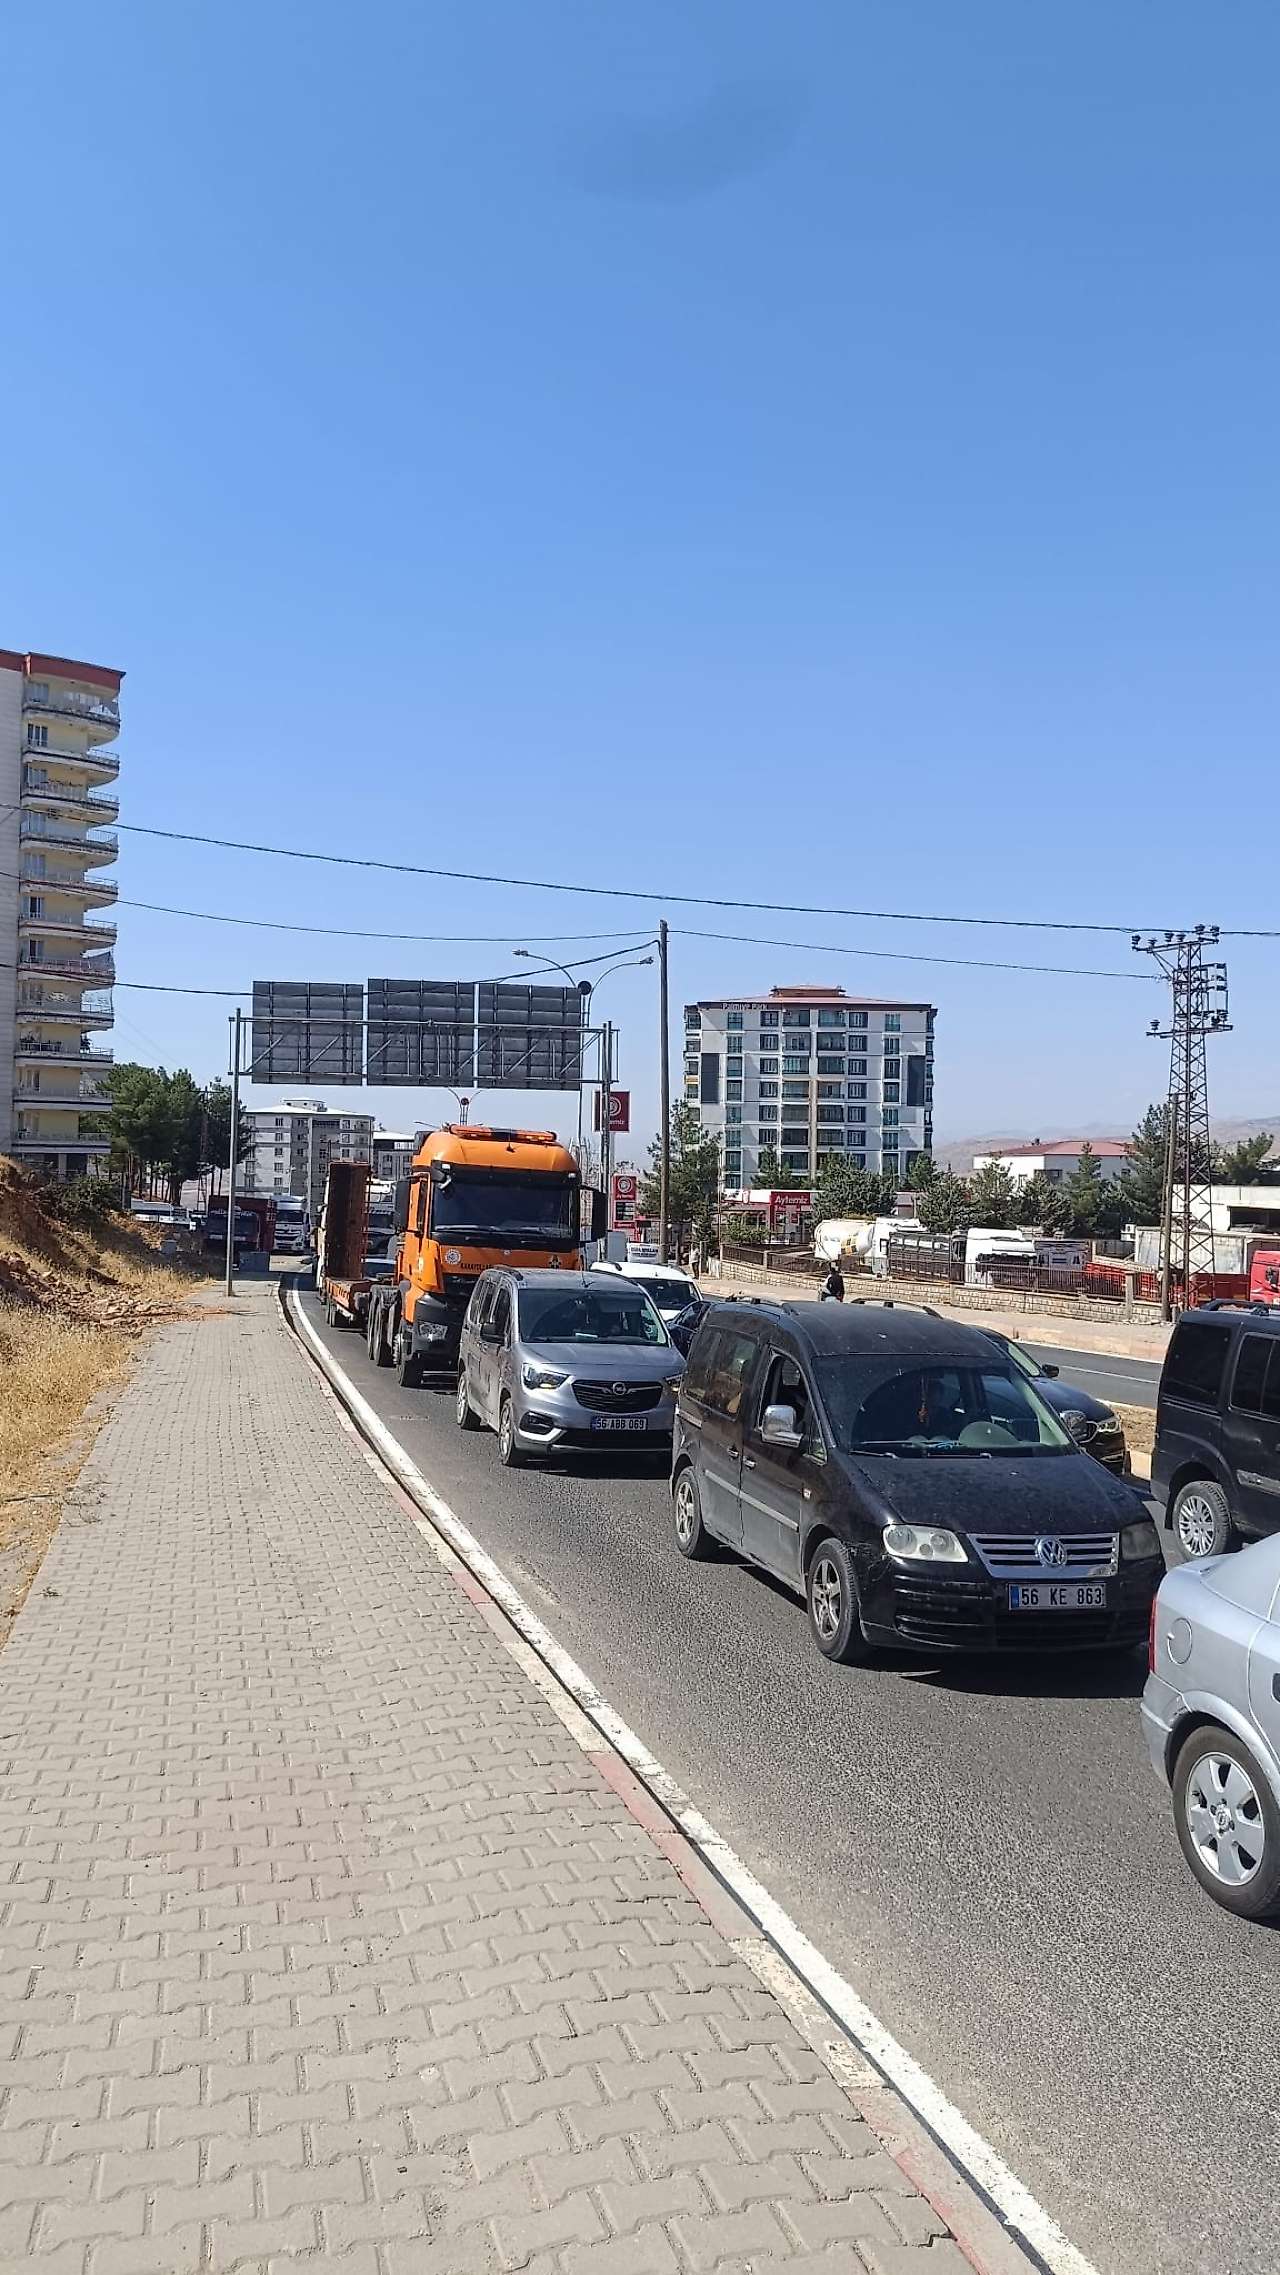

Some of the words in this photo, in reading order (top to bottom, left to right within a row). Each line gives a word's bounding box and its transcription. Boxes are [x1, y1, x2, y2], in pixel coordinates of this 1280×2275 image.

[1021, 1588, 1039, 1605] 56
[1050, 1587, 1067, 1605] KE
[1077, 1587, 1102, 1605] 863
